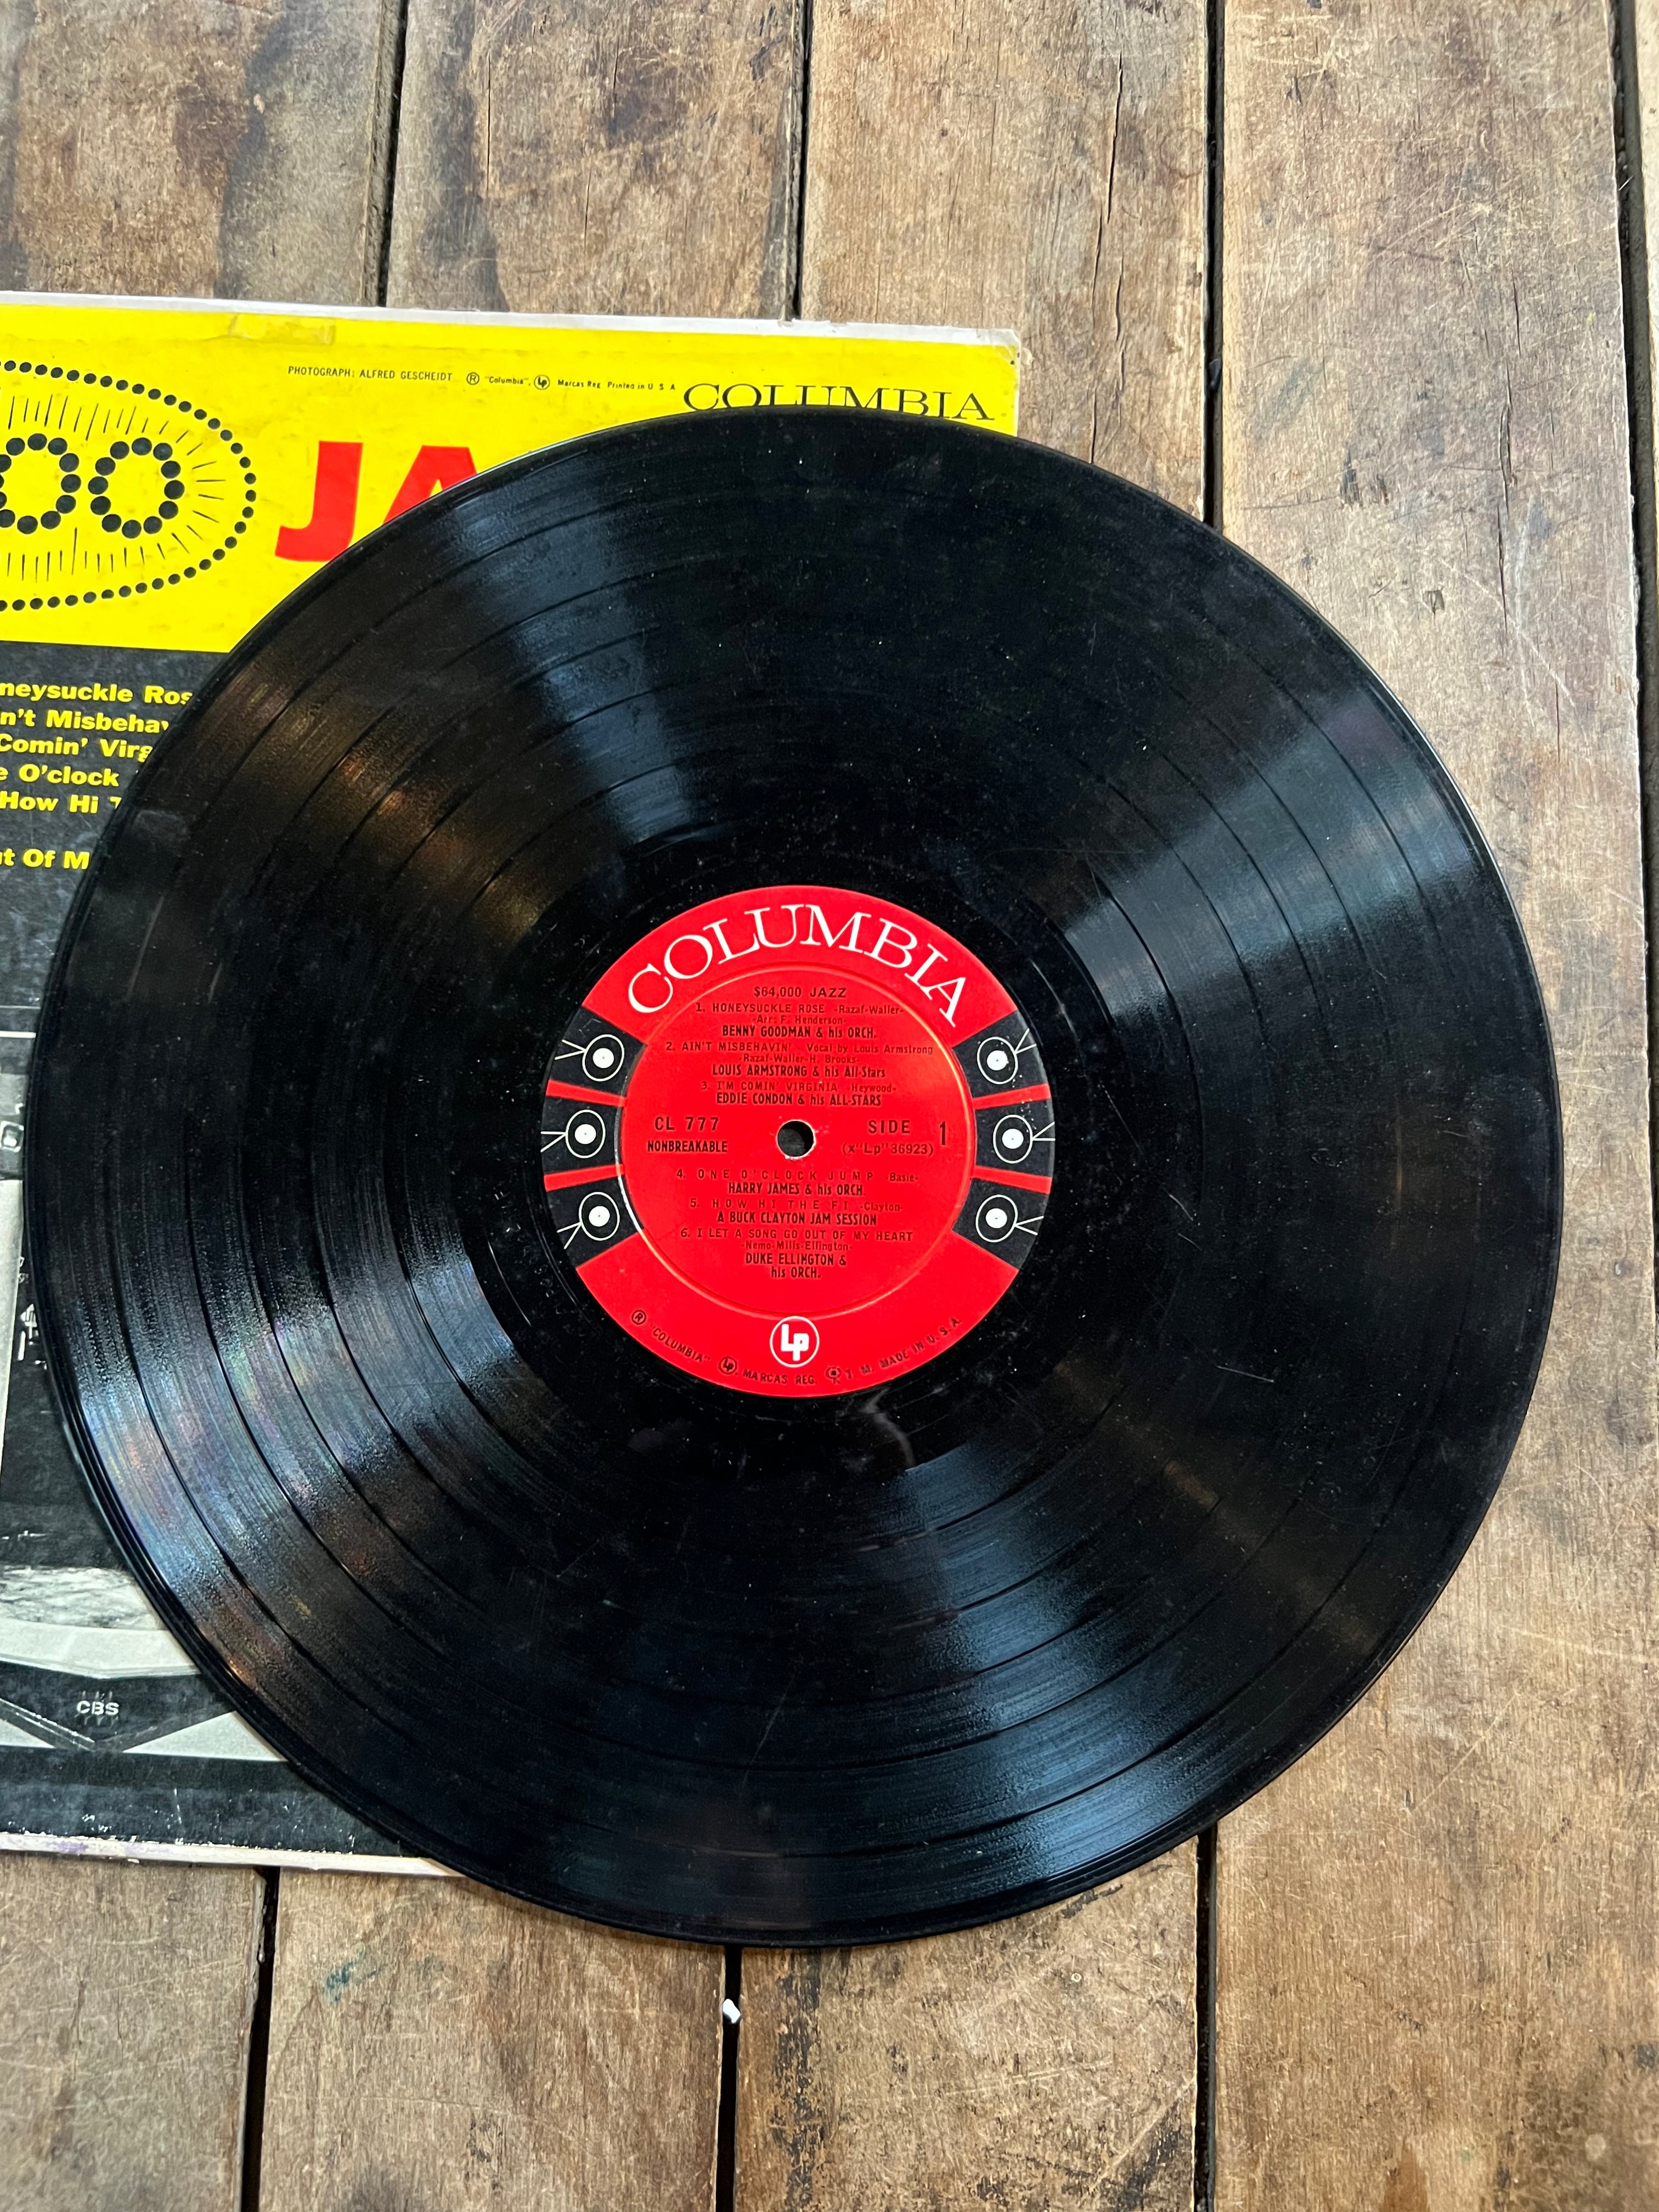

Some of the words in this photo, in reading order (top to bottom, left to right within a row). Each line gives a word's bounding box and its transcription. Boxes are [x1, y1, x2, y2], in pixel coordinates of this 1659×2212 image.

[288, 366, 354, 377] PHOTOGRAPH:
[359, 369, 395, 379] ALFRED
[400, 371, 452, 381] GESCHEIDT
[607, 381, 635, 390] Printed
[684, 383, 995, 420] COLUMBIA
[19, 764, 119, 787] O'clock
[0, 791, 59, 811] How
[69, 794, 99, 814] Hi
[22, 849, 56, 868] Of
[628, 904, 966, 1027] COLUMBIA
[754, 986, 802, 999] $64,000
[810, 987, 847, 998] JAZZ
[696, 1002, 706, 1012] 1.
[713, 1003, 791, 1013] HONEYSUCKLE
[799, 1004, 825, 1013] ROSE
[723, 1025, 755, 1036] BENNY
[761, 1026, 810, 1037] GOODMAN
[816, 1027, 823, 1037] &
[828, 1027, 842, 1038] his
[848, 1027, 877, 1039] ORCH.
[666, 1042, 675, 1051] 2.
[681, 1042, 712, 1051] AIN'T
[719, 1042, 791, 1052] MISBEHAVIN'
[806, 1043, 832, 1052] Vocal
[838, 1044, 848, 1054] by
[854, 1045, 879, 1053] Louis
[884, 1045, 933, 1054] Armstrong
[713, 1064, 741, 1076] LOUIS
[747, 1065, 808, 1076] ARMSTRONG
[812, 1066, 819, 1076] &
[825, 1065, 839, 1077] his
[844, 1066, 885, 1077] All-Stars
[702, 1081, 710, 1090] 3.
[718, 1081, 733, 1090] I'M
[741, 1081, 779, 1090] COMIN'
[786, 1082, 837, 1091] VIRGINIA
[716, 1092, 747, 1103] EDDIE
[753, 1093, 792, 1104] CONDON
[798, 1094, 805, 1104] &
[810, 1094, 824, 1105] his
[830, 1094, 881, 1106] ALL-STARS
[655, 1116, 675, 1130] CL
[686, 1116, 719, 1131] 777
[868, 1120, 910, 1133] SIDE
[939, 1121, 946, 1145] 1
[647, 1141, 727, 1152] NONBREAKABLE
[676, 1169, 685, 1178] 4.
[698, 1169, 730, 1180] ONE
[741, 1170, 816, 1180] O'CLOCK
[828, 1171, 873, 1181] JUMP
[729, 1182, 762, 1194] HARRY
[768, 1183, 799, 1194] JAMES
[805, 1184, 812, 1194] &
[817, 1184, 832, 1195] his
[837, 1184, 866, 1196] ORCH.
[690, 1198, 699, 1207] 5.
[713, 1199, 747, 1208] HOW
[759, 1199, 776, 1209] HI
[788, 1200, 819, 1209] THE
[832, 1200, 848, 1210] FI
[717, 1211, 724, 1222] A
[730, 1211, 755, 1223] BUCK
[761, 1212, 805, 1224] CLAYTON
[810, 1212, 831, 1224] JAM
[837, 1214, 876, 1225] SESSION
[681, 1228, 690, 1237] 6.
[698, 1228, 702, 1237] I
[709, 1228, 729, 1238] LET
[735, 1229, 742, 1238] A
[749, 1229, 777, 1239] SONG
[785, 1229, 798, 1239] GO
[805, 1229, 826, 1239] OUT
[833, 1230, 846, 1240] OF
[854, 1231, 870, 1240] MY
[876, 1231, 913, 1241] HEART
[746, 1252, 773, 1264] DUKE
[778, 1253, 834, 1265] ELLINGTON
[839, 1254, 847, 1265] &
[771, 1266, 786, 1278] his
[791, 1266, 821, 1278] ORCH.
[742, 1368, 788, 1384] MARCAS
[795, 1374, 818, 1385] REG.
[880, 1351, 909, 1369] MADE
[912, 1340, 925, 1353] IN
[77, 1701, 119, 1716] CBS
